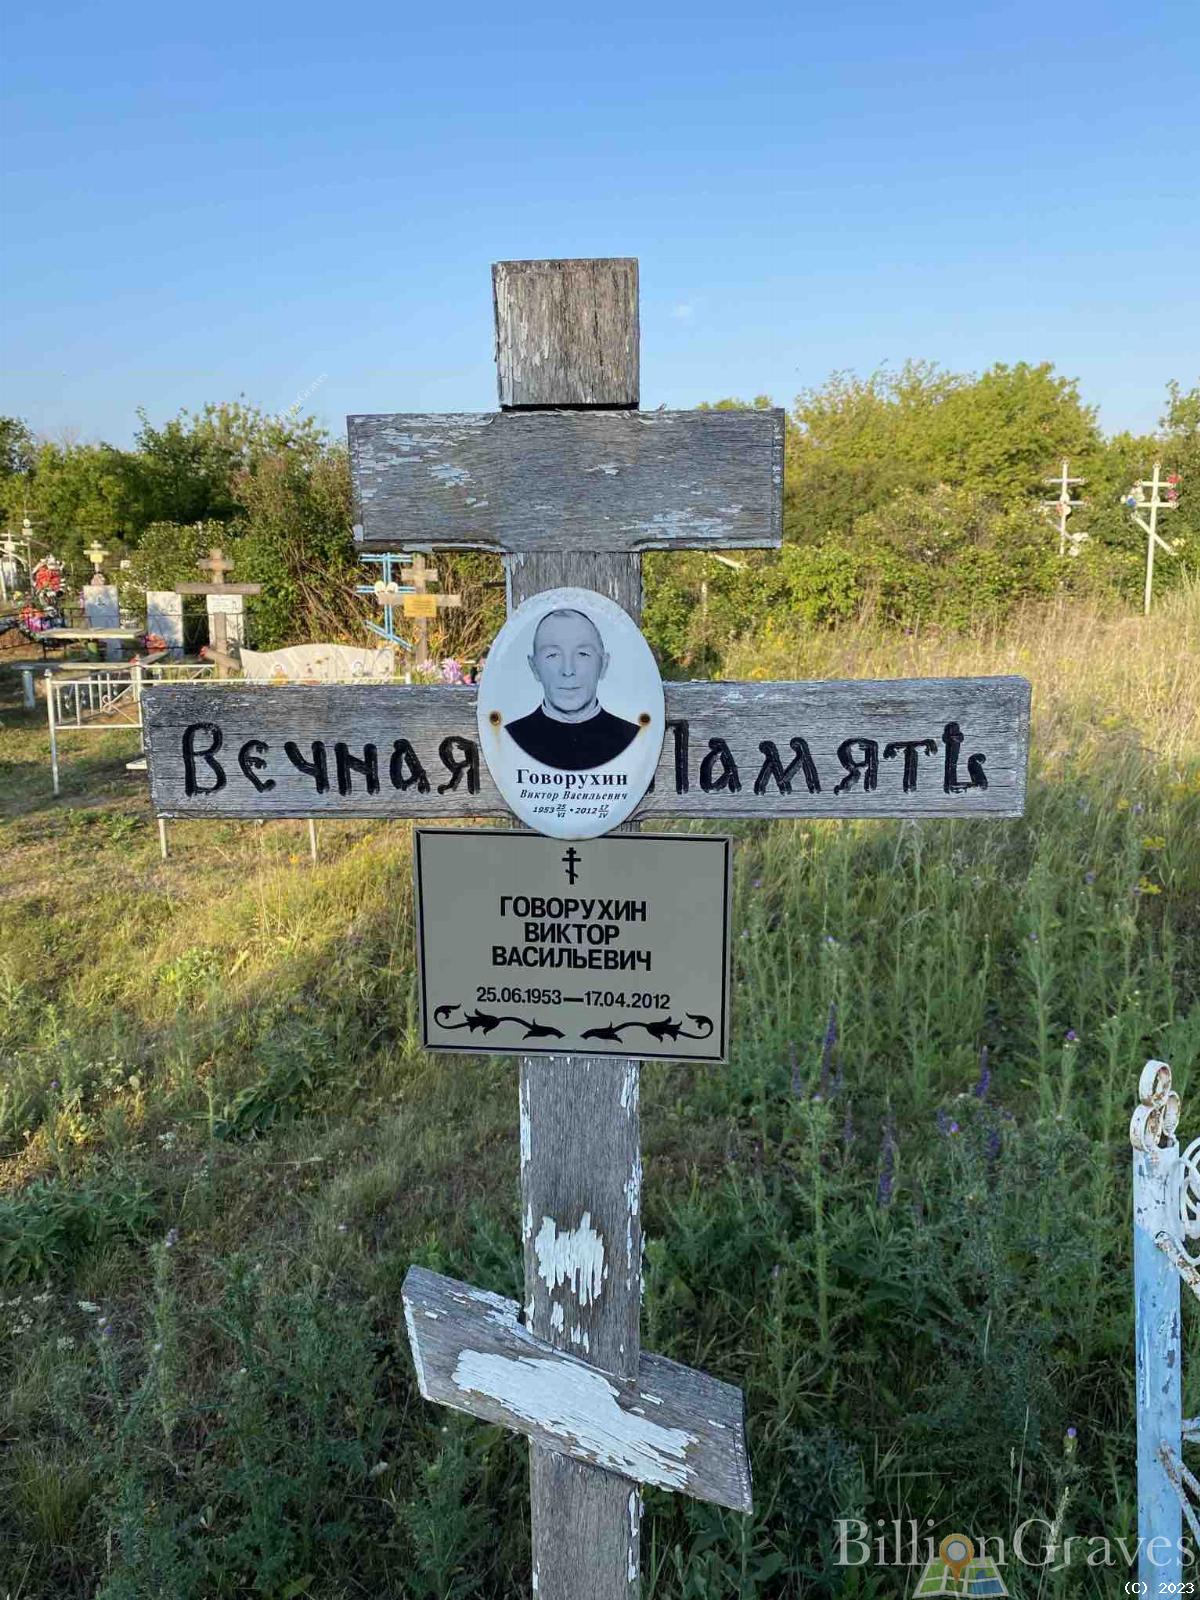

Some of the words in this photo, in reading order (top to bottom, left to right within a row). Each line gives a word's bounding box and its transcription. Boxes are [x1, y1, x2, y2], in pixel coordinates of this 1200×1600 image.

[516, 769, 628, 789] Говорухин
[520, 789, 560, 801] Виктор
[563, 790, 628, 801] Васильевич
[500, 896, 647, 922] ГОВОРУХИН
[524, 922, 620, 945] ВИКТОР
[492, 946, 651, 971] ВАСИЛЬЕВИЧ
